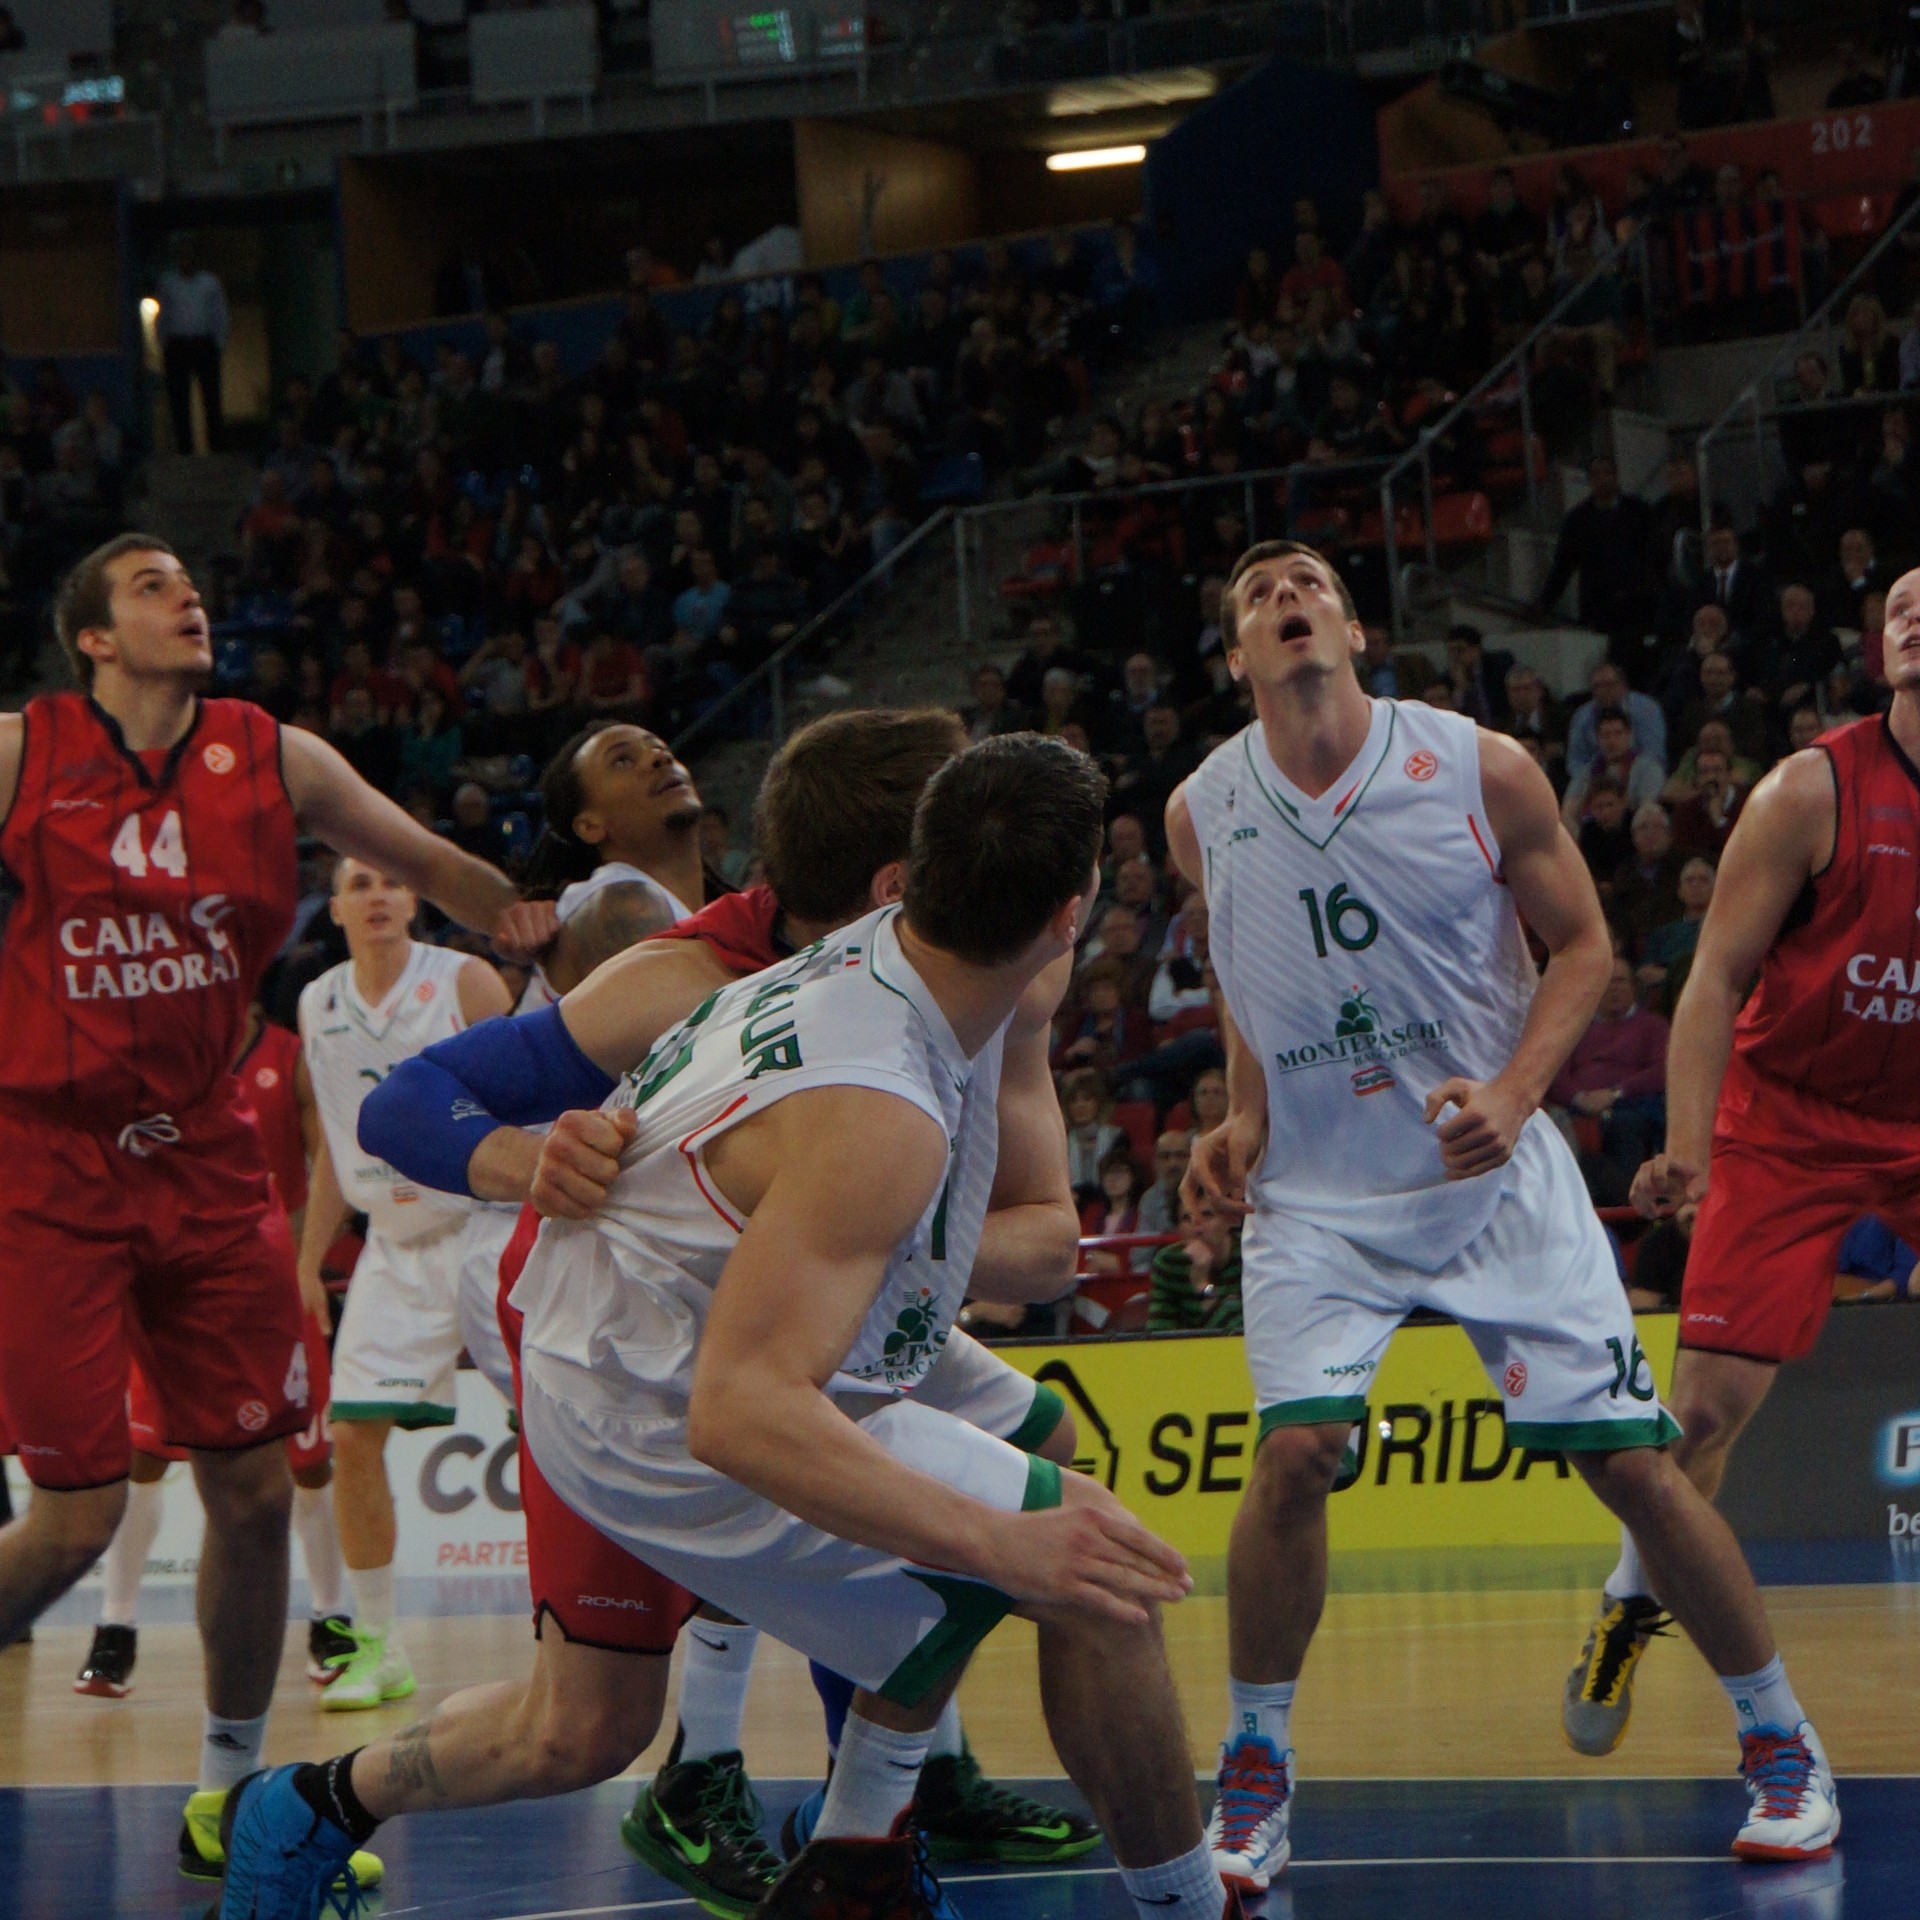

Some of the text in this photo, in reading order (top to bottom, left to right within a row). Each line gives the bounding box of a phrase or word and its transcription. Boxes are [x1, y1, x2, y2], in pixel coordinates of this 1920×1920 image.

[1811, 113, 1872, 153] 202
[110, 809, 188, 878] 44
[1299, 882, 1379, 958] 16
[1842, 990, 1920, 1024] LAB
[1604, 1333, 1655, 1402] 16
[1145, 1400, 1572, 1496] SEURIDA
[437, 1541, 527, 1567] PARTE
[577, 1594, 652, 1612] ROYAL
